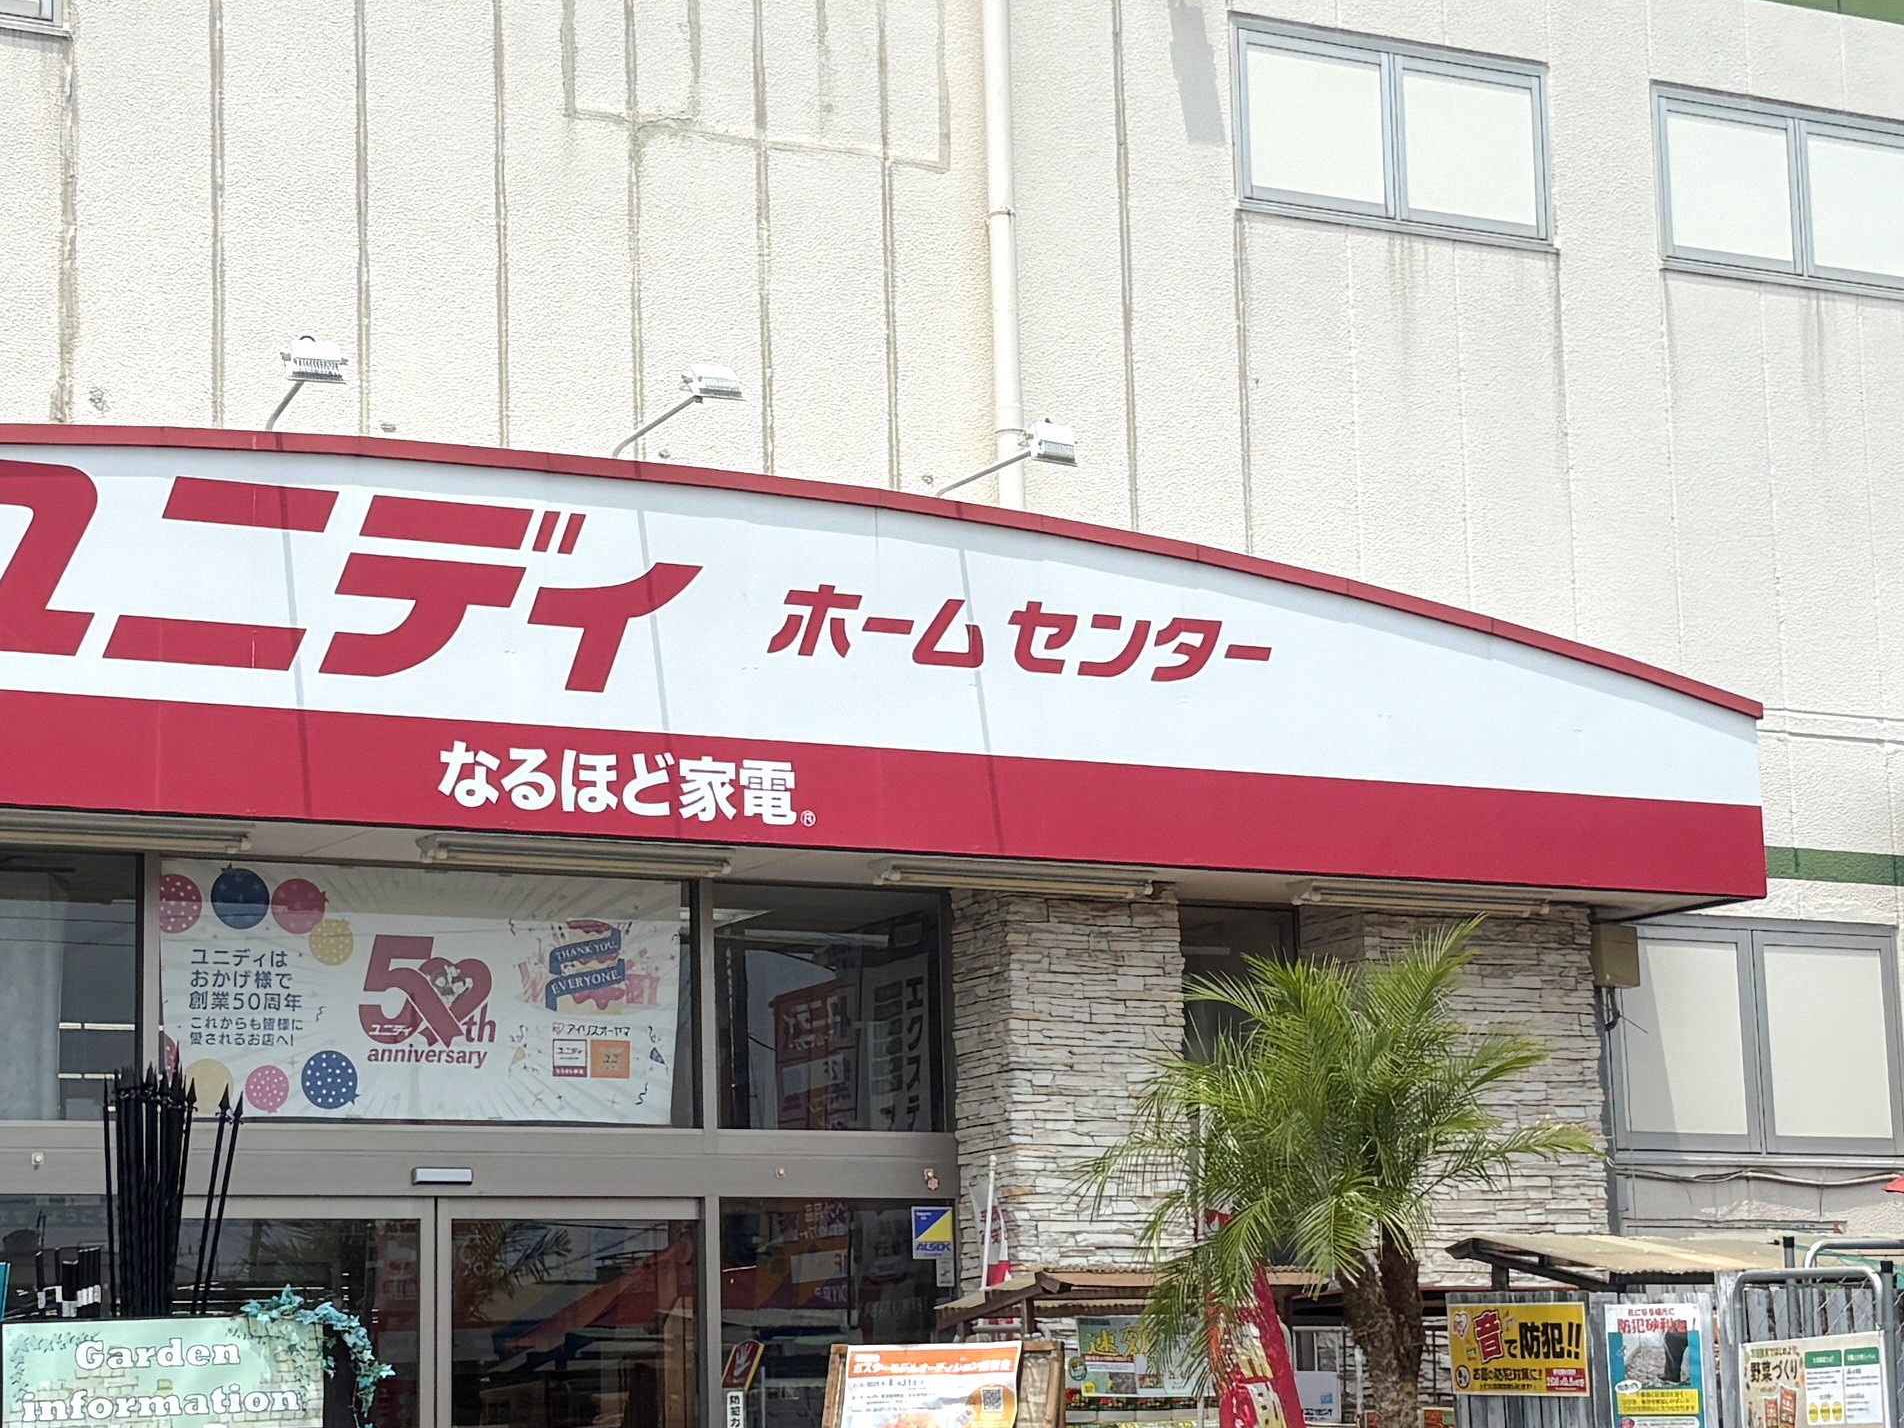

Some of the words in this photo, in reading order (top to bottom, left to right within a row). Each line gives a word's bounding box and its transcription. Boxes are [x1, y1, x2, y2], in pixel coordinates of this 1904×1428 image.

[768, 583, 1273, 681] ホームセンター
[191, 948, 289, 968] ユニディは
[555, 944, 591, 961] THANK
[190, 970, 293, 990] おかげ様で
[189, 991, 303, 1012] 創業50周年
[367, 1044, 488, 1069] anniversary
[916, 1243, 952, 1252] ALSOK
[73, 1337, 241, 1371] Garden
[1750, 1358, 1798, 1383] 野菜づくり
[22, 1383, 301, 1423] information
